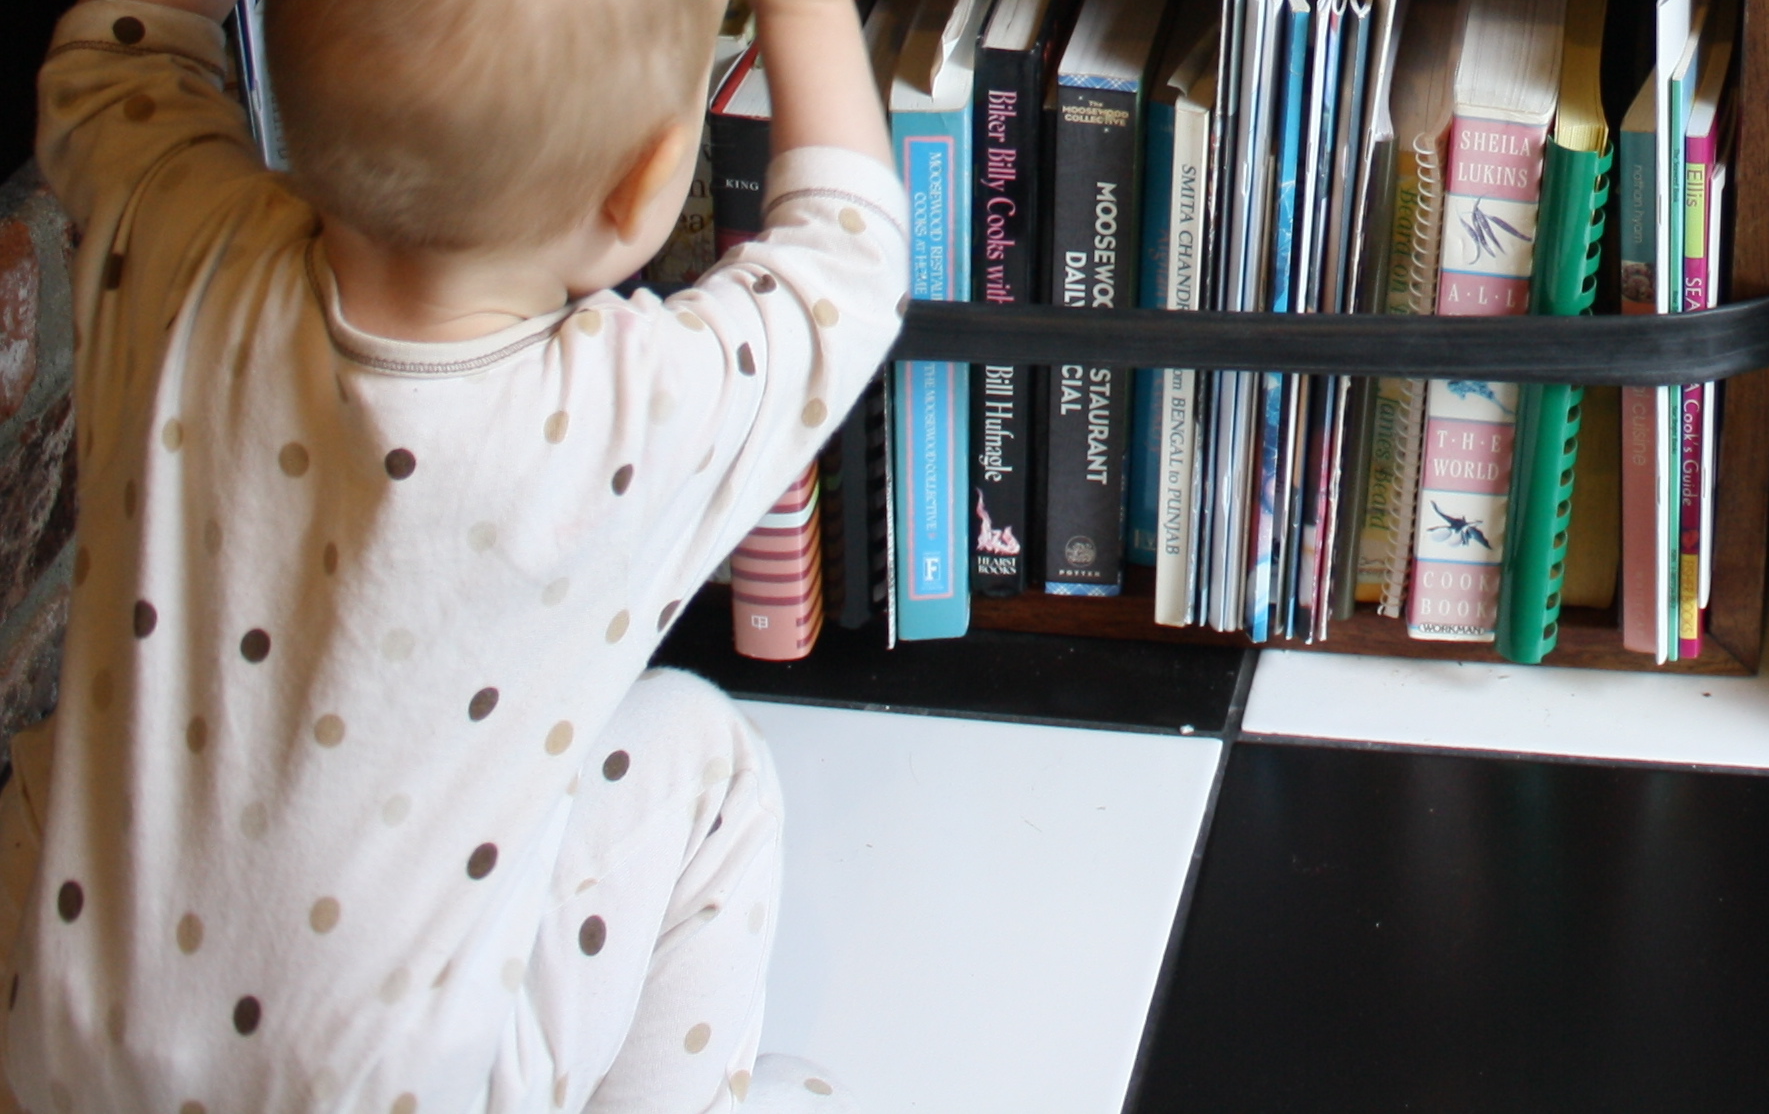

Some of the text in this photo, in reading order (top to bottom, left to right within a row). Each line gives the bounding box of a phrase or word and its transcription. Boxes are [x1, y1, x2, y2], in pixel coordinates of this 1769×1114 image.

[1062, 105, 1129, 120] MOOSEWOOD
[1064, 114, 1126, 128] COLLECTIVE
[1461, 131, 1531, 157] SHEILA
[725, 179, 759, 191] KING
[981, 90, 1017, 261] Biker Billy Cooks
[1459, 162, 1528, 188] LUKINS
[1686, 169, 1703, 207] Ellis
[929, 152, 942, 242] MOOSEWOOD
[1179, 164, 1196, 224] SMITA
[978, 365, 1014, 482] Bill Hufnagle
[1632, 401, 1647, 466] cuisine
[1682, 399, 1699, 506] Cook's Guide
[1165, 397, 1186, 554] BENGAL PUNJAB
[1434, 459, 1498, 481] WORLD
[978, 565, 1017, 575] BOOKS
[1423, 572, 1491, 591] COOK
[1421, 598, 1486, 618] BOOK
[1421, 624, 1483, 635] WORKMAN
